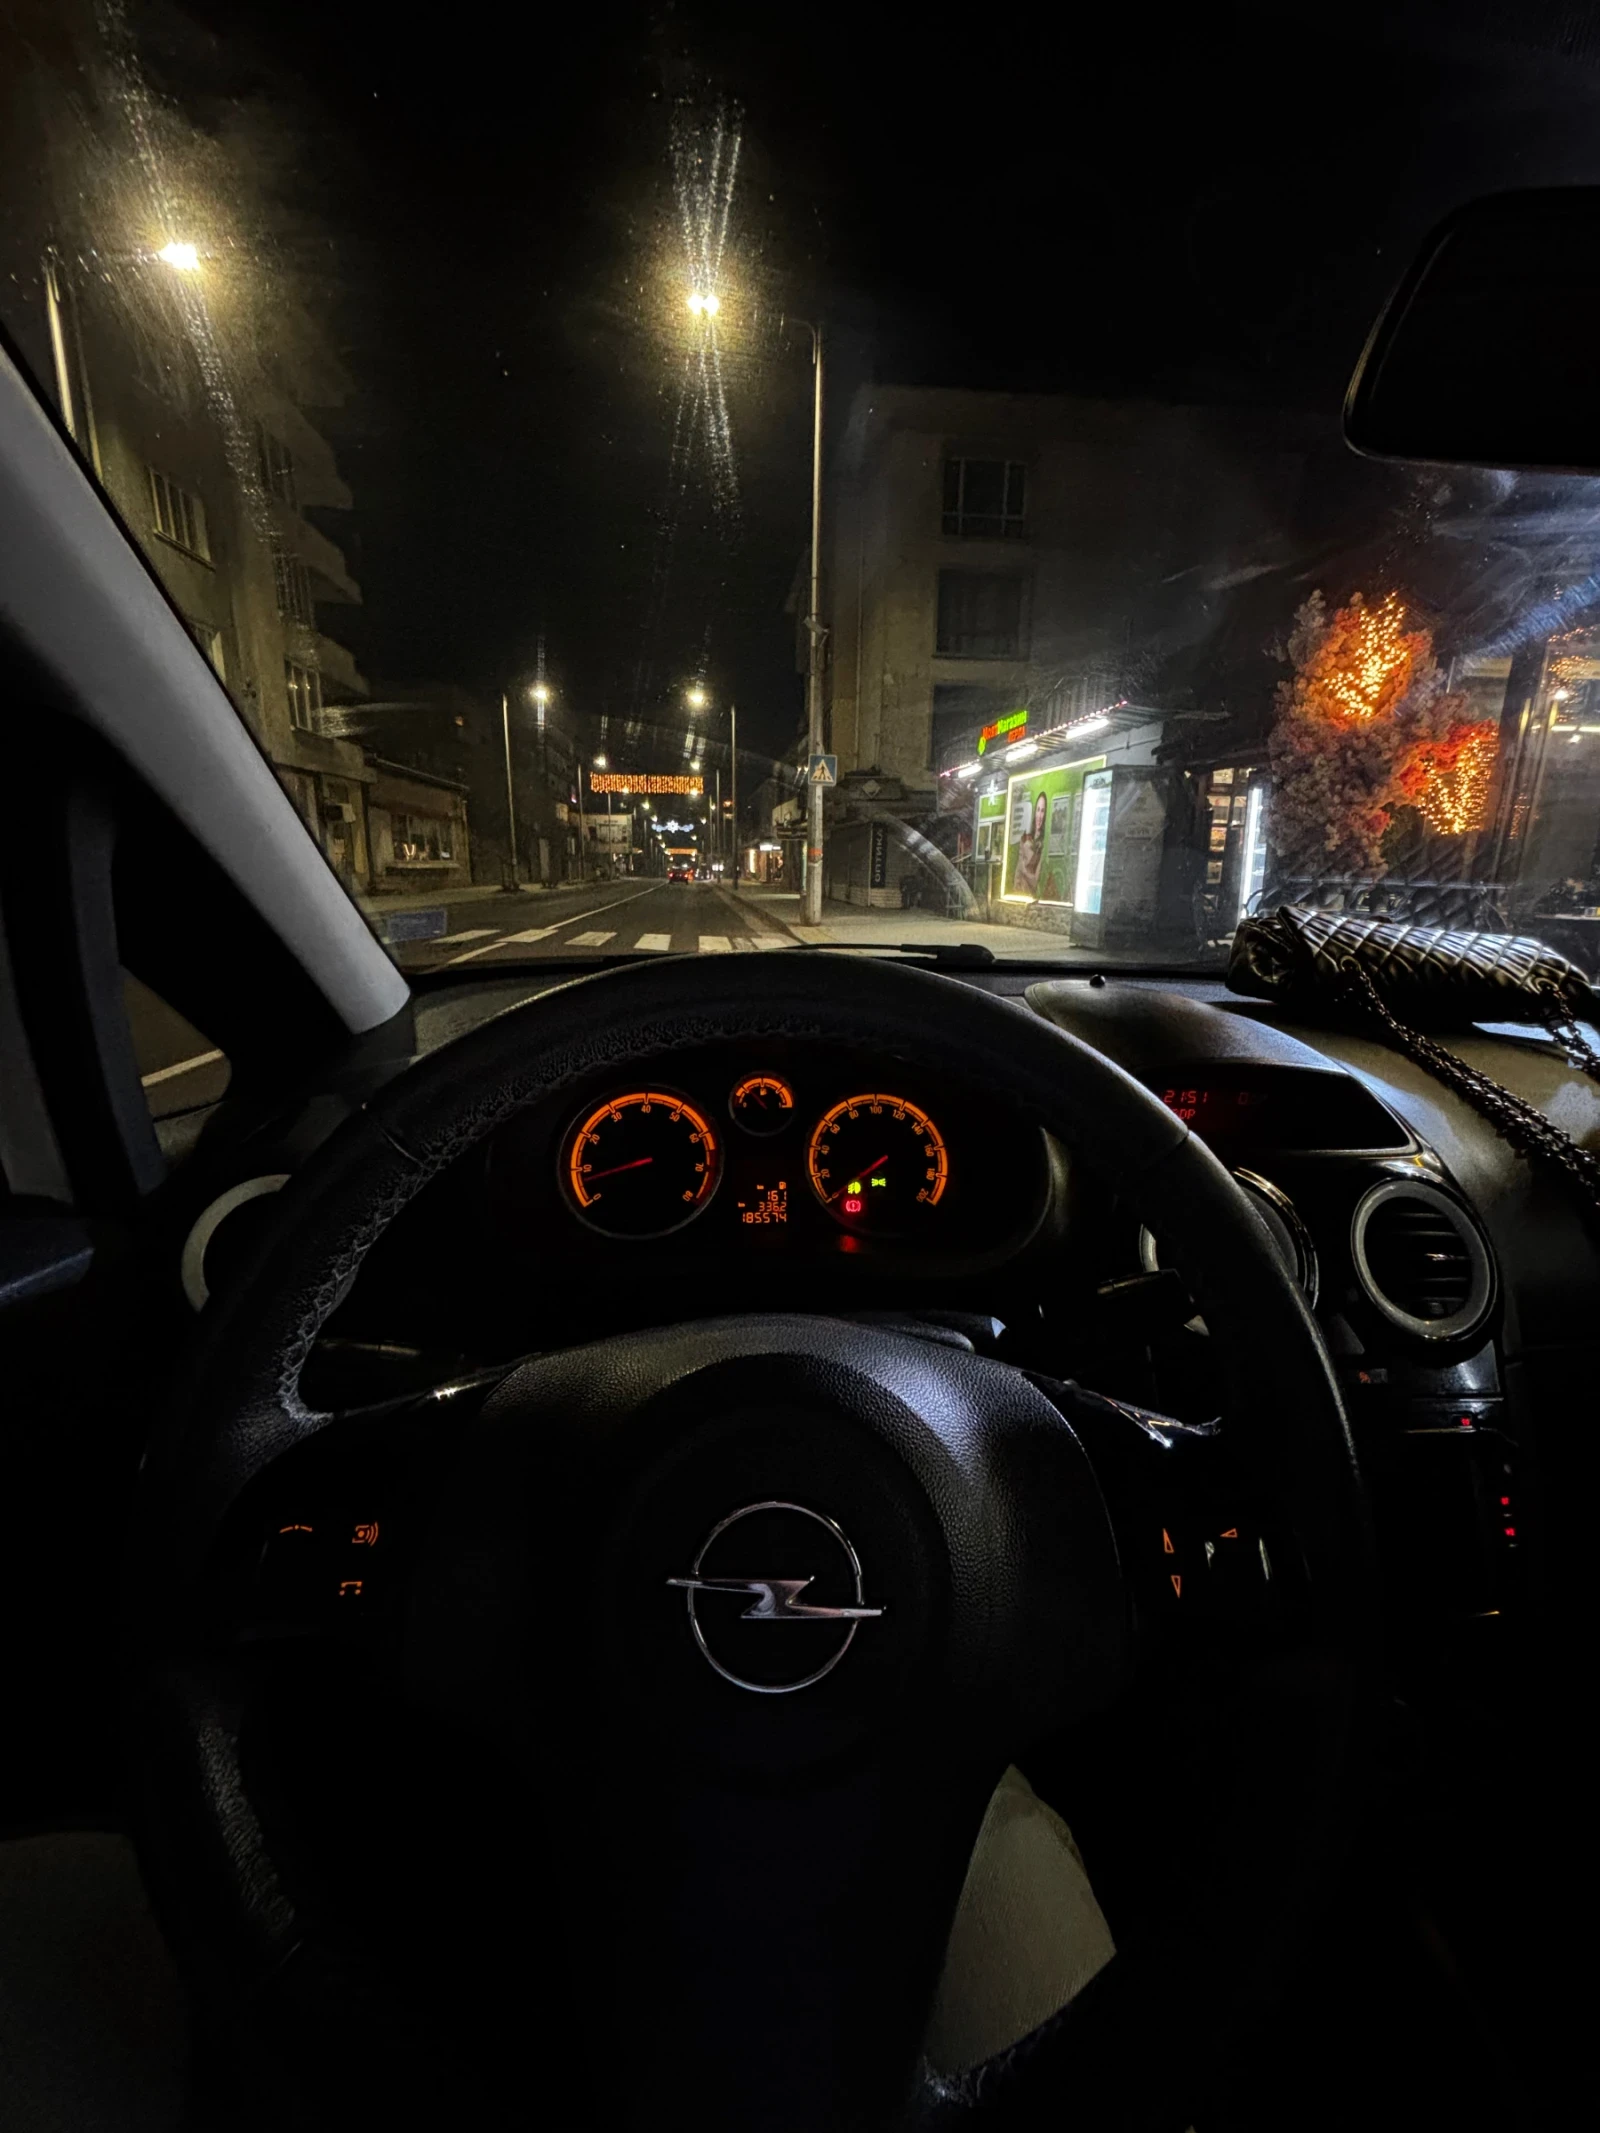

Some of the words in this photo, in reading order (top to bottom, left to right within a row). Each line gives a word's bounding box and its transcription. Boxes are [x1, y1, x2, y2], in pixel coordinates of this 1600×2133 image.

[641, 1104, 652, 1113] 40
[869, 1105, 883, 1115] 100
[610, 1112, 623, 1123] 30
[669, 1112, 681, 1122] 50
[848, 1109, 860, 1120] 80
[892, 1109, 906, 1121] 120
[830, 1123, 841, 1135] 60
[911, 1122, 924, 1136] 140
[589, 1134, 601, 1145] 20
[688, 1132, 700, 1144] 60
[820, 1144, 831, 1155] 40
[923, 1143, 935, 1157] 160
[583, 1164, 593, 1173] 10
[694, 1162, 705, 1172] 70
[820, 1168, 831, 1179] 20
[925, 1167, 936, 1181] 180
[593, 1192, 602, 1201] 0
[682, 1190, 694, 1202] 80
[767, 1190, 787, 1201] 161
[915, 1187, 930, 1202] 200
[742, 1212, 787, 1224] 185574
